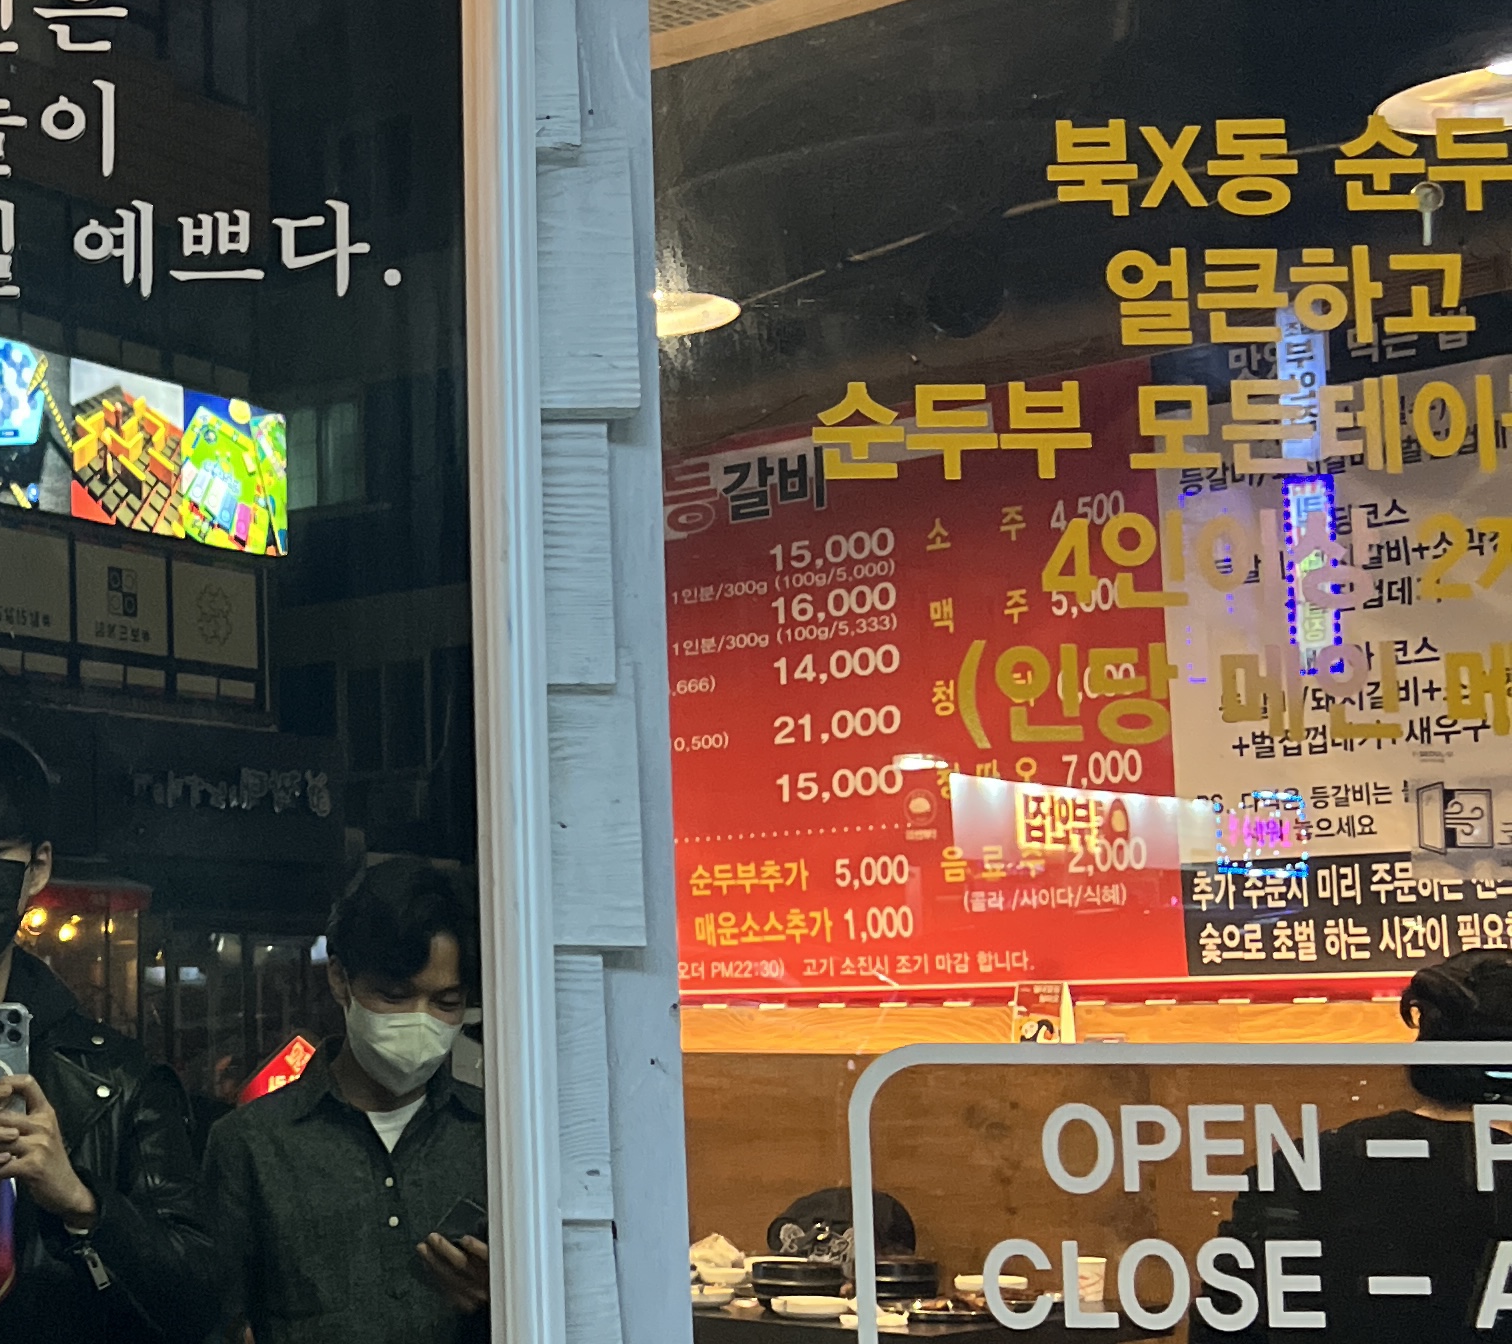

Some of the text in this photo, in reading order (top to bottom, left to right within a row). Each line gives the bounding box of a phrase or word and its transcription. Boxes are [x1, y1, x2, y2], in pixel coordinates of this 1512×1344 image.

[1046, 118, 1298, 217] 북X동
[73, 198, 402, 299] 예쁘다.
[1105, 244, 1476, 346] 얼큰하고
[812, 380, 1092, 480] 순두부
[1130, 374, 1512, 475] 모든테이
[770, 527, 896, 572] 15,000
[1042, 508, 1380, 608] 4인이상
[671, 577, 768, 607] 1인분/300g
[771, 581, 897, 625] 16,000
[672, 632, 769, 657] 1인분/300g
[773, 644, 900, 686] 14,000
[958, 641, 1178, 749] (인당
[1220, 641, 1403, 742] 메인
[774, 704, 901, 745] 21,000
[776, 764, 904, 804] 15,000
[1062, 748, 1143, 787] 7,000
[1310, 781, 1393, 810] 등갈비는
[689, 854, 910, 896] 순두부추가 5,000
[1067, 836, 1147, 877] 2,000
[1192, 871, 1237, 911] 추가
[1316, 864, 1362, 906] 미리
[694, 905, 914, 947] 매운소스추가 1,000
[1199, 922, 1266, 964] 숯으로
[1272, 918, 1318, 961] 초벌
[1323, 917, 1372, 961] 하는
[1379, 913, 1450, 959] 시간이
[802, 957, 835, 977] 고기
[840, 954, 889, 976] 소진시
[895, 953, 929, 975] 조기
[935, 951, 970, 974] 마감
[976, 949, 1035, 973] 합니다.
[1042, 1102, 1322, 1195] OPEN
[982, 1237, 1327, 1333] CLOSE
